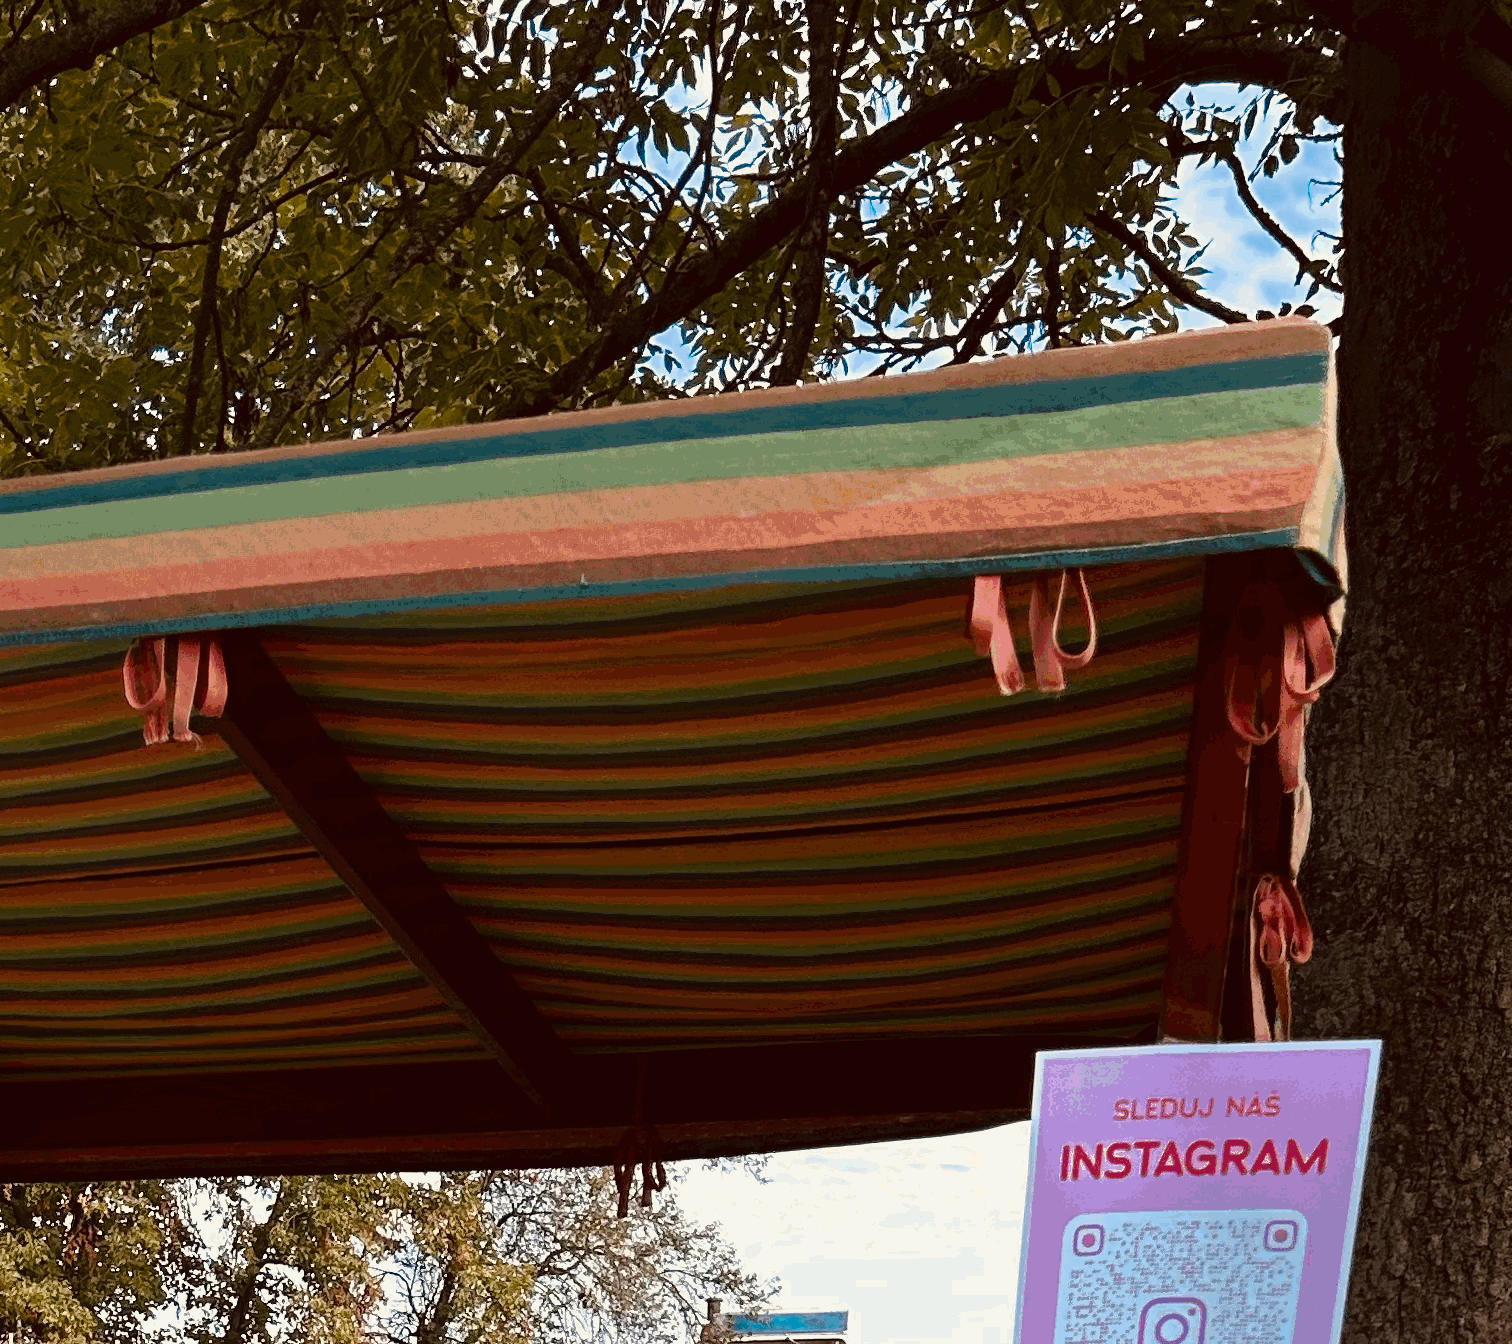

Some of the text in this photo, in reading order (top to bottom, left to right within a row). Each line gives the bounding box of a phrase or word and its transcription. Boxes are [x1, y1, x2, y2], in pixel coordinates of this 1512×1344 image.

[1112, 1089, 1281, 1122] SLEDUJ NÁŠ
[1058, 1137, 1330, 1182] INSTAGRAM
